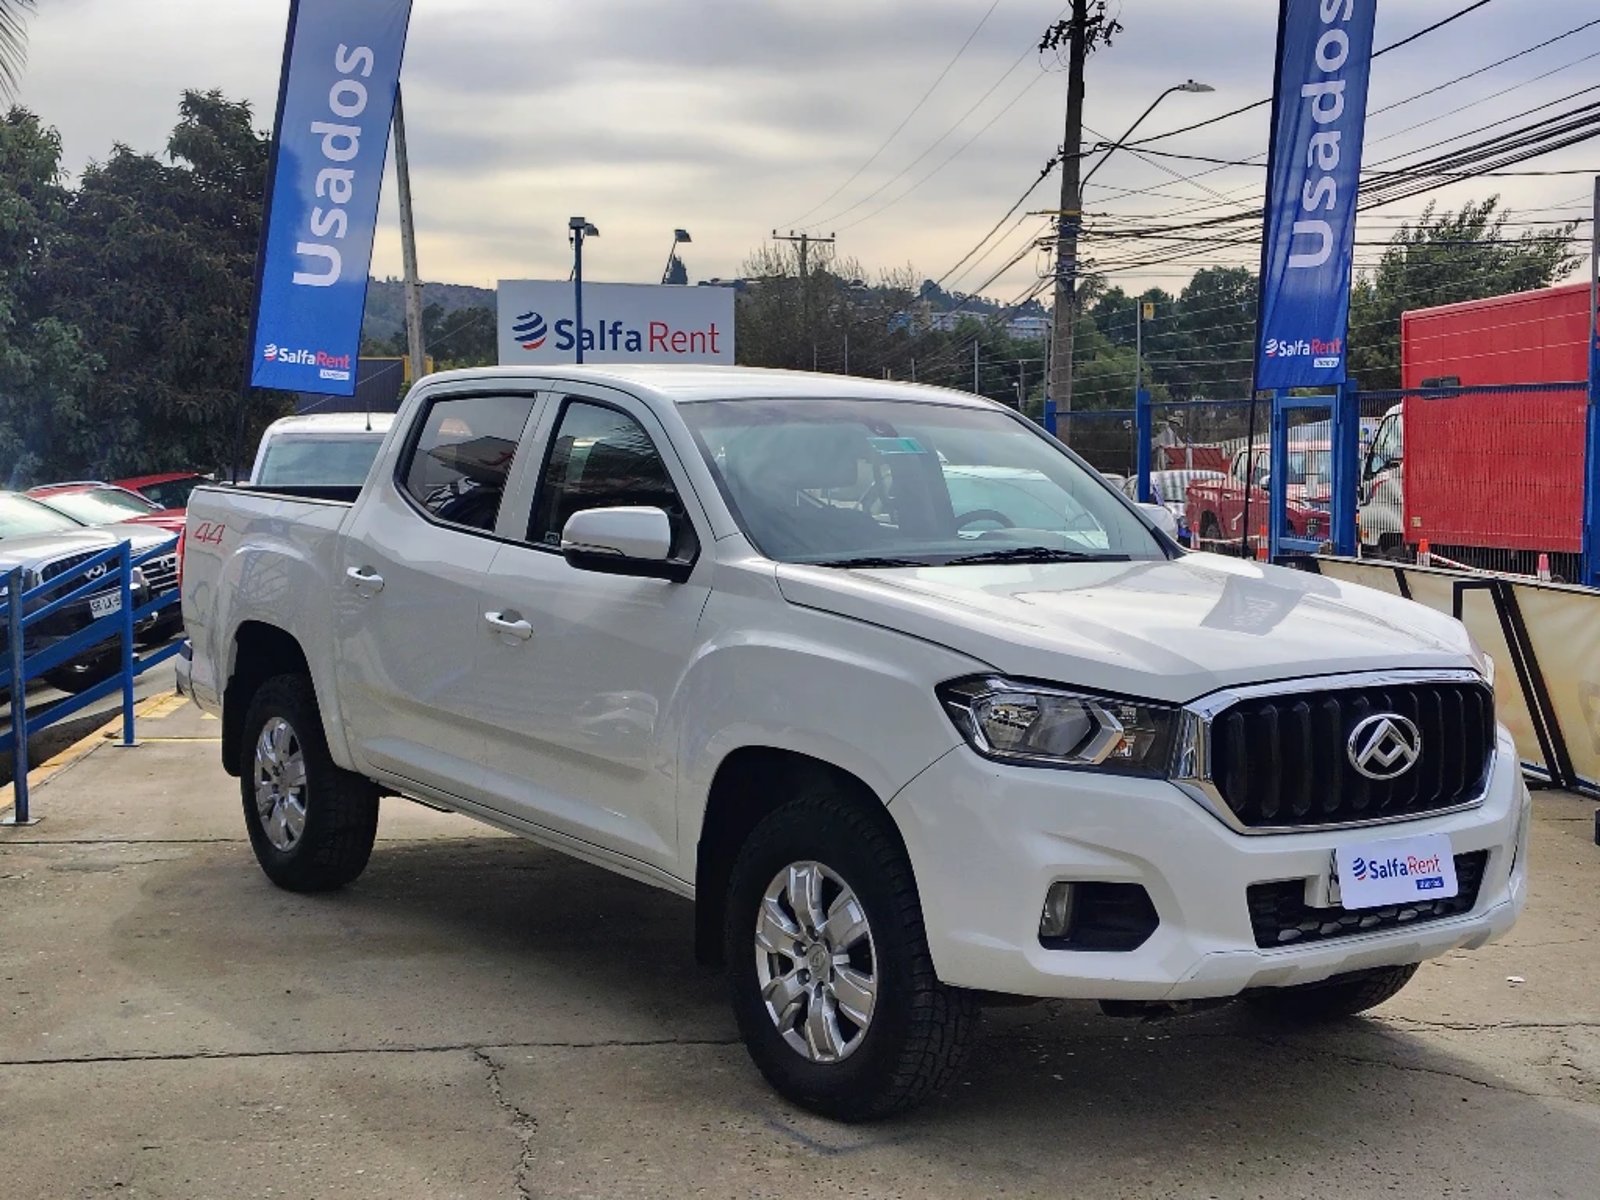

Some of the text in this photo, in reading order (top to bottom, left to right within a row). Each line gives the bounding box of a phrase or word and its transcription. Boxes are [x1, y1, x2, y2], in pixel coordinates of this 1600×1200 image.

[292, 43, 374, 287] Usados
[278, 347, 350, 370] SalfaRent
[1278, 337, 1342, 356] SalfaRent
[1369, 854, 1441, 879] SalfaRent
